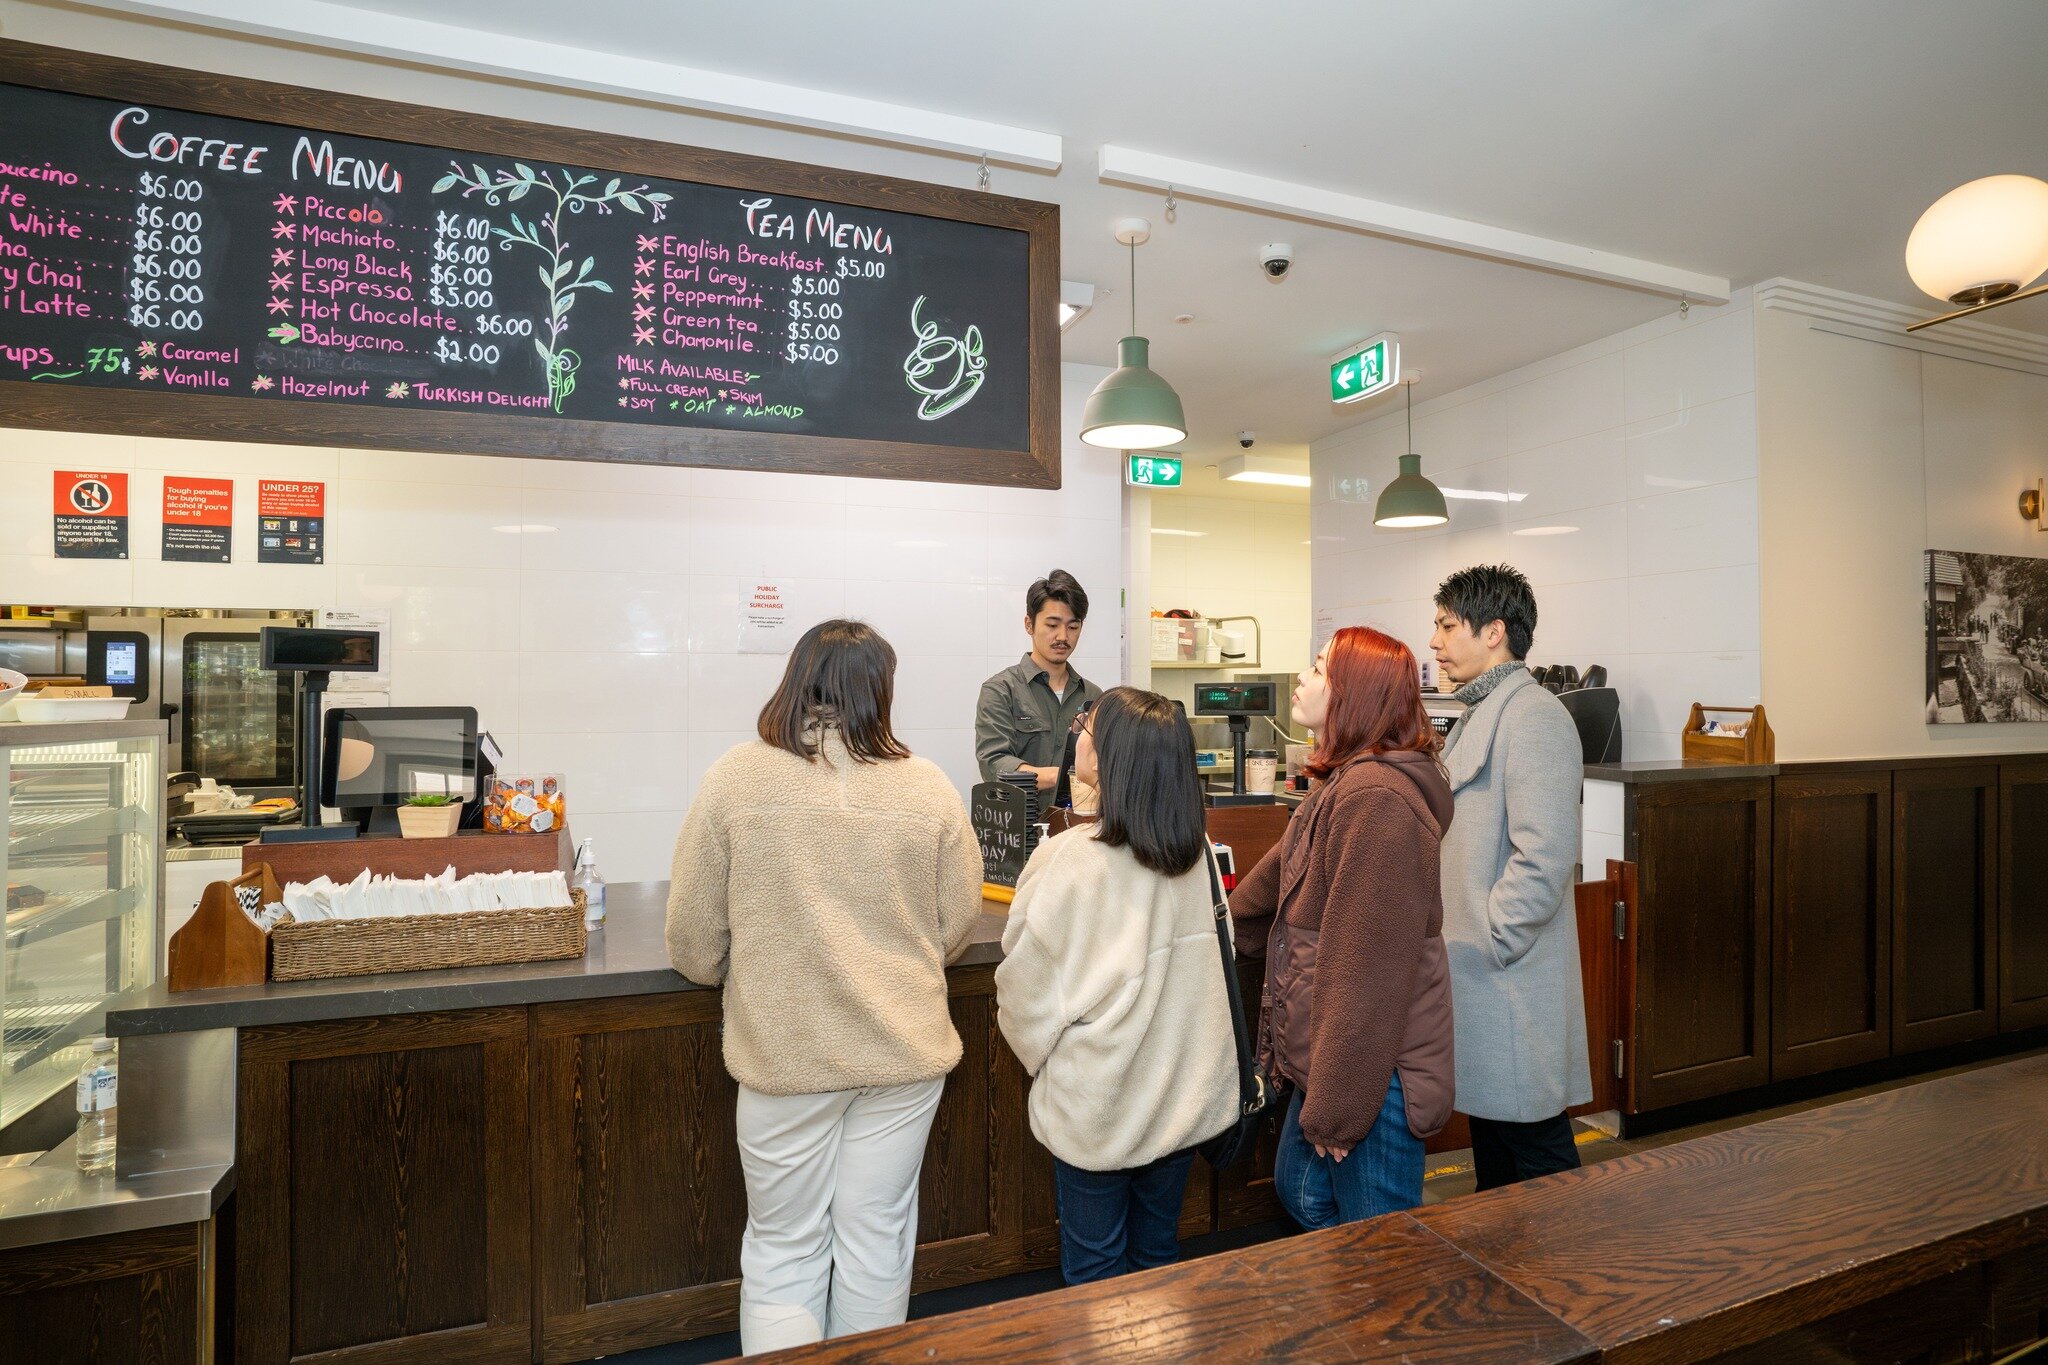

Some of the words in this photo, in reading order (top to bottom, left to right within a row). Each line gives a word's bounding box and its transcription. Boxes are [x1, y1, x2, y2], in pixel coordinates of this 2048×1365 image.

[110, 108, 268, 174] COFFEE
[291, 137, 402, 193] MENU
[139, 172, 202, 202] $6.00
[136, 203, 202, 233] $6.00
[305, 196, 383, 224] Piccolo
[435, 210, 490, 241] $6.00
[739, 198, 795, 240] TEA
[805, 208, 893, 255] MENU
[10, 213, 82, 238] White
[134, 230, 201, 255] $6.00
[302, 224, 395, 251] Machiato
[433, 238, 490, 264] $6.00
[133, 254, 202, 280] $6.00
[301, 249, 349, 278] Long
[355, 253, 412, 283] Black
[430, 263, 493, 286] $6.00
[663, 235, 730, 264] English
[738, 243, 825, 273] Breakfast
[835, 256, 886, 280] $5.00
[27, 262, 82, 290] Chai
[130, 277, 204, 303] $6.00
[301, 273, 413, 300] Espresso
[430, 285, 493, 309] $5.00
[663, 261, 700, 281] Earl
[708, 267, 748, 294] Grey
[791, 274, 840, 296] $5.00
[21, 290, 91, 317] Latte
[130, 303, 203, 331] $6.00
[663, 282, 763, 308] Peppermint
[788, 299, 842, 320] $5.00
[301, 298, 341, 321] Hot
[350, 302, 457, 331] Chocolate
[476, 314, 533, 336] $6.00
[663, 308, 721, 330] Green
[726, 313, 758, 333] tea
[787, 321, 841, 341] $5.00
[162, 342, 239, 364] Caramel
[301, 323, 404, 352] Babyccino
[434, 335, 500, 365] $2.00
[662, 329, 754, 353] Chamomile
[785, 341, 839, 365] $5.00
[163, 366, 230, 388] Vanilla
[617, 354, 655, 374] MILK
[281, 376, 370, 397] Hazelnut
[412, 382, 483, 404] TURKISH
[487, 391, 550, 409] DELIGHT
[630, 377, 662, 393] FULL
[666, 383, 709, 399] CREAM
[729, 388, 763, 406] SKIM
[630, 397, 657, 413] SOY
[684, 398, 717, 413] OAT
[743, 404, 804, 419] ALMOND
[167, 486, 191, 495] Tough
[180, 495, 206, 503] buying
[262, 484, 299, 492] UNDER
[64, 690, 99, 699] SMALL
[974, 804, 1013, 829] SOUP
[976, 826, 992, 841] OF
[994, 830, 1022, 848] THE
[982, 844, 1006, 862] DAY
